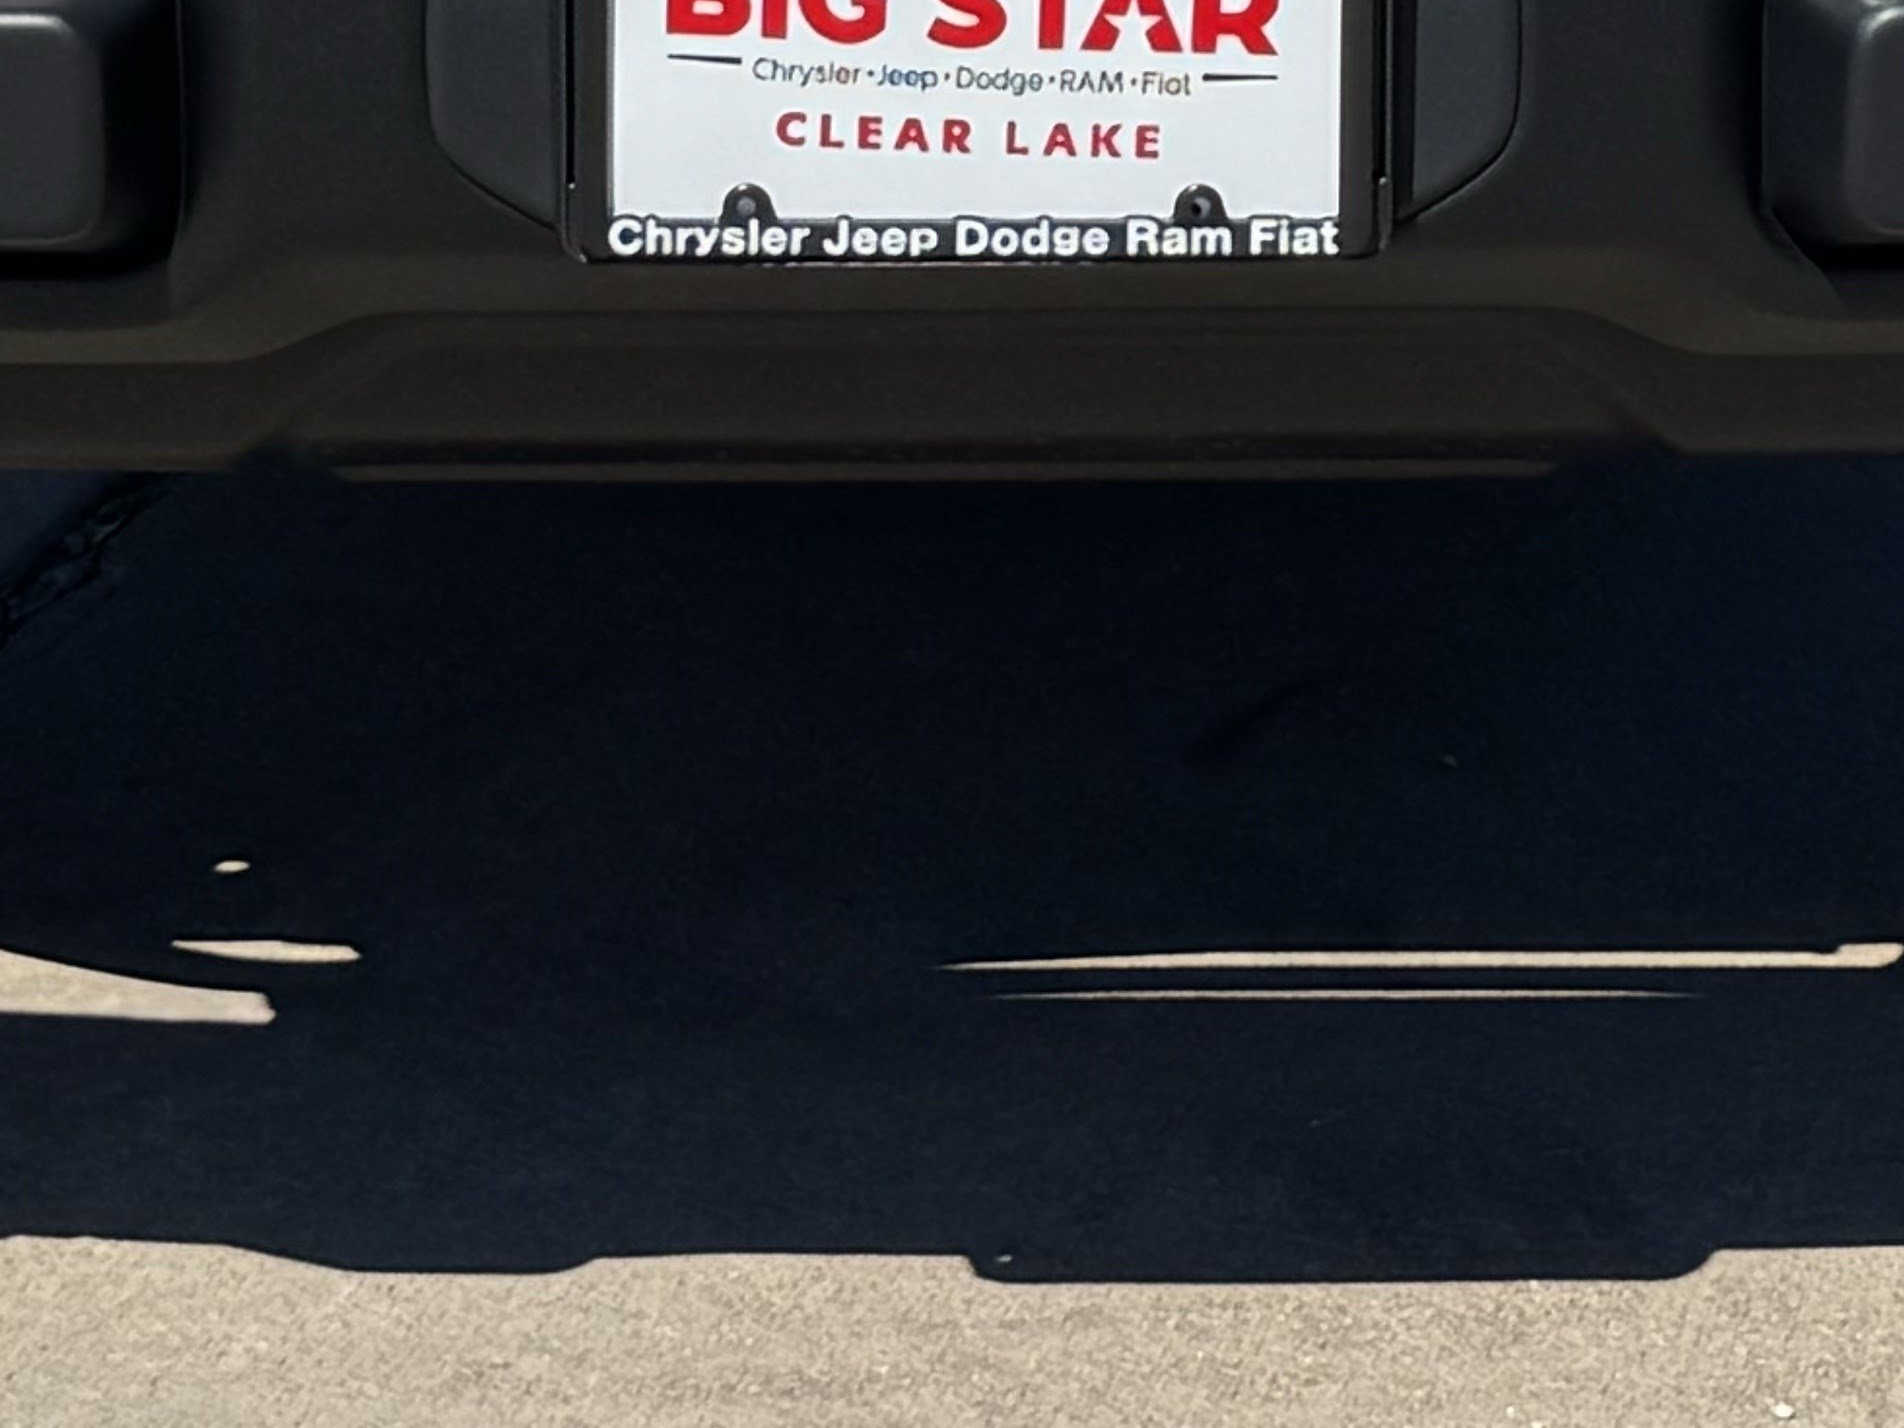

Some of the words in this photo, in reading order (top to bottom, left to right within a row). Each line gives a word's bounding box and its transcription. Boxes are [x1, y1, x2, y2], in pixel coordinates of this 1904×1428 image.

[955, 65, 1043, 95] Dodge
[1060, 69, 1124, 95] RAM
[776, 112, 971, 154] CLEAR
[1007, 122, 1162, 158] LAKE
[608, 218, 811, 257] Chrysler
[823, 218, 939, 257] Jeep
[955, 218, 1110, 256] Dodge
[1125, 218, 1233, 256] Ram
[1249, 218, 1339, 256] Fiat
